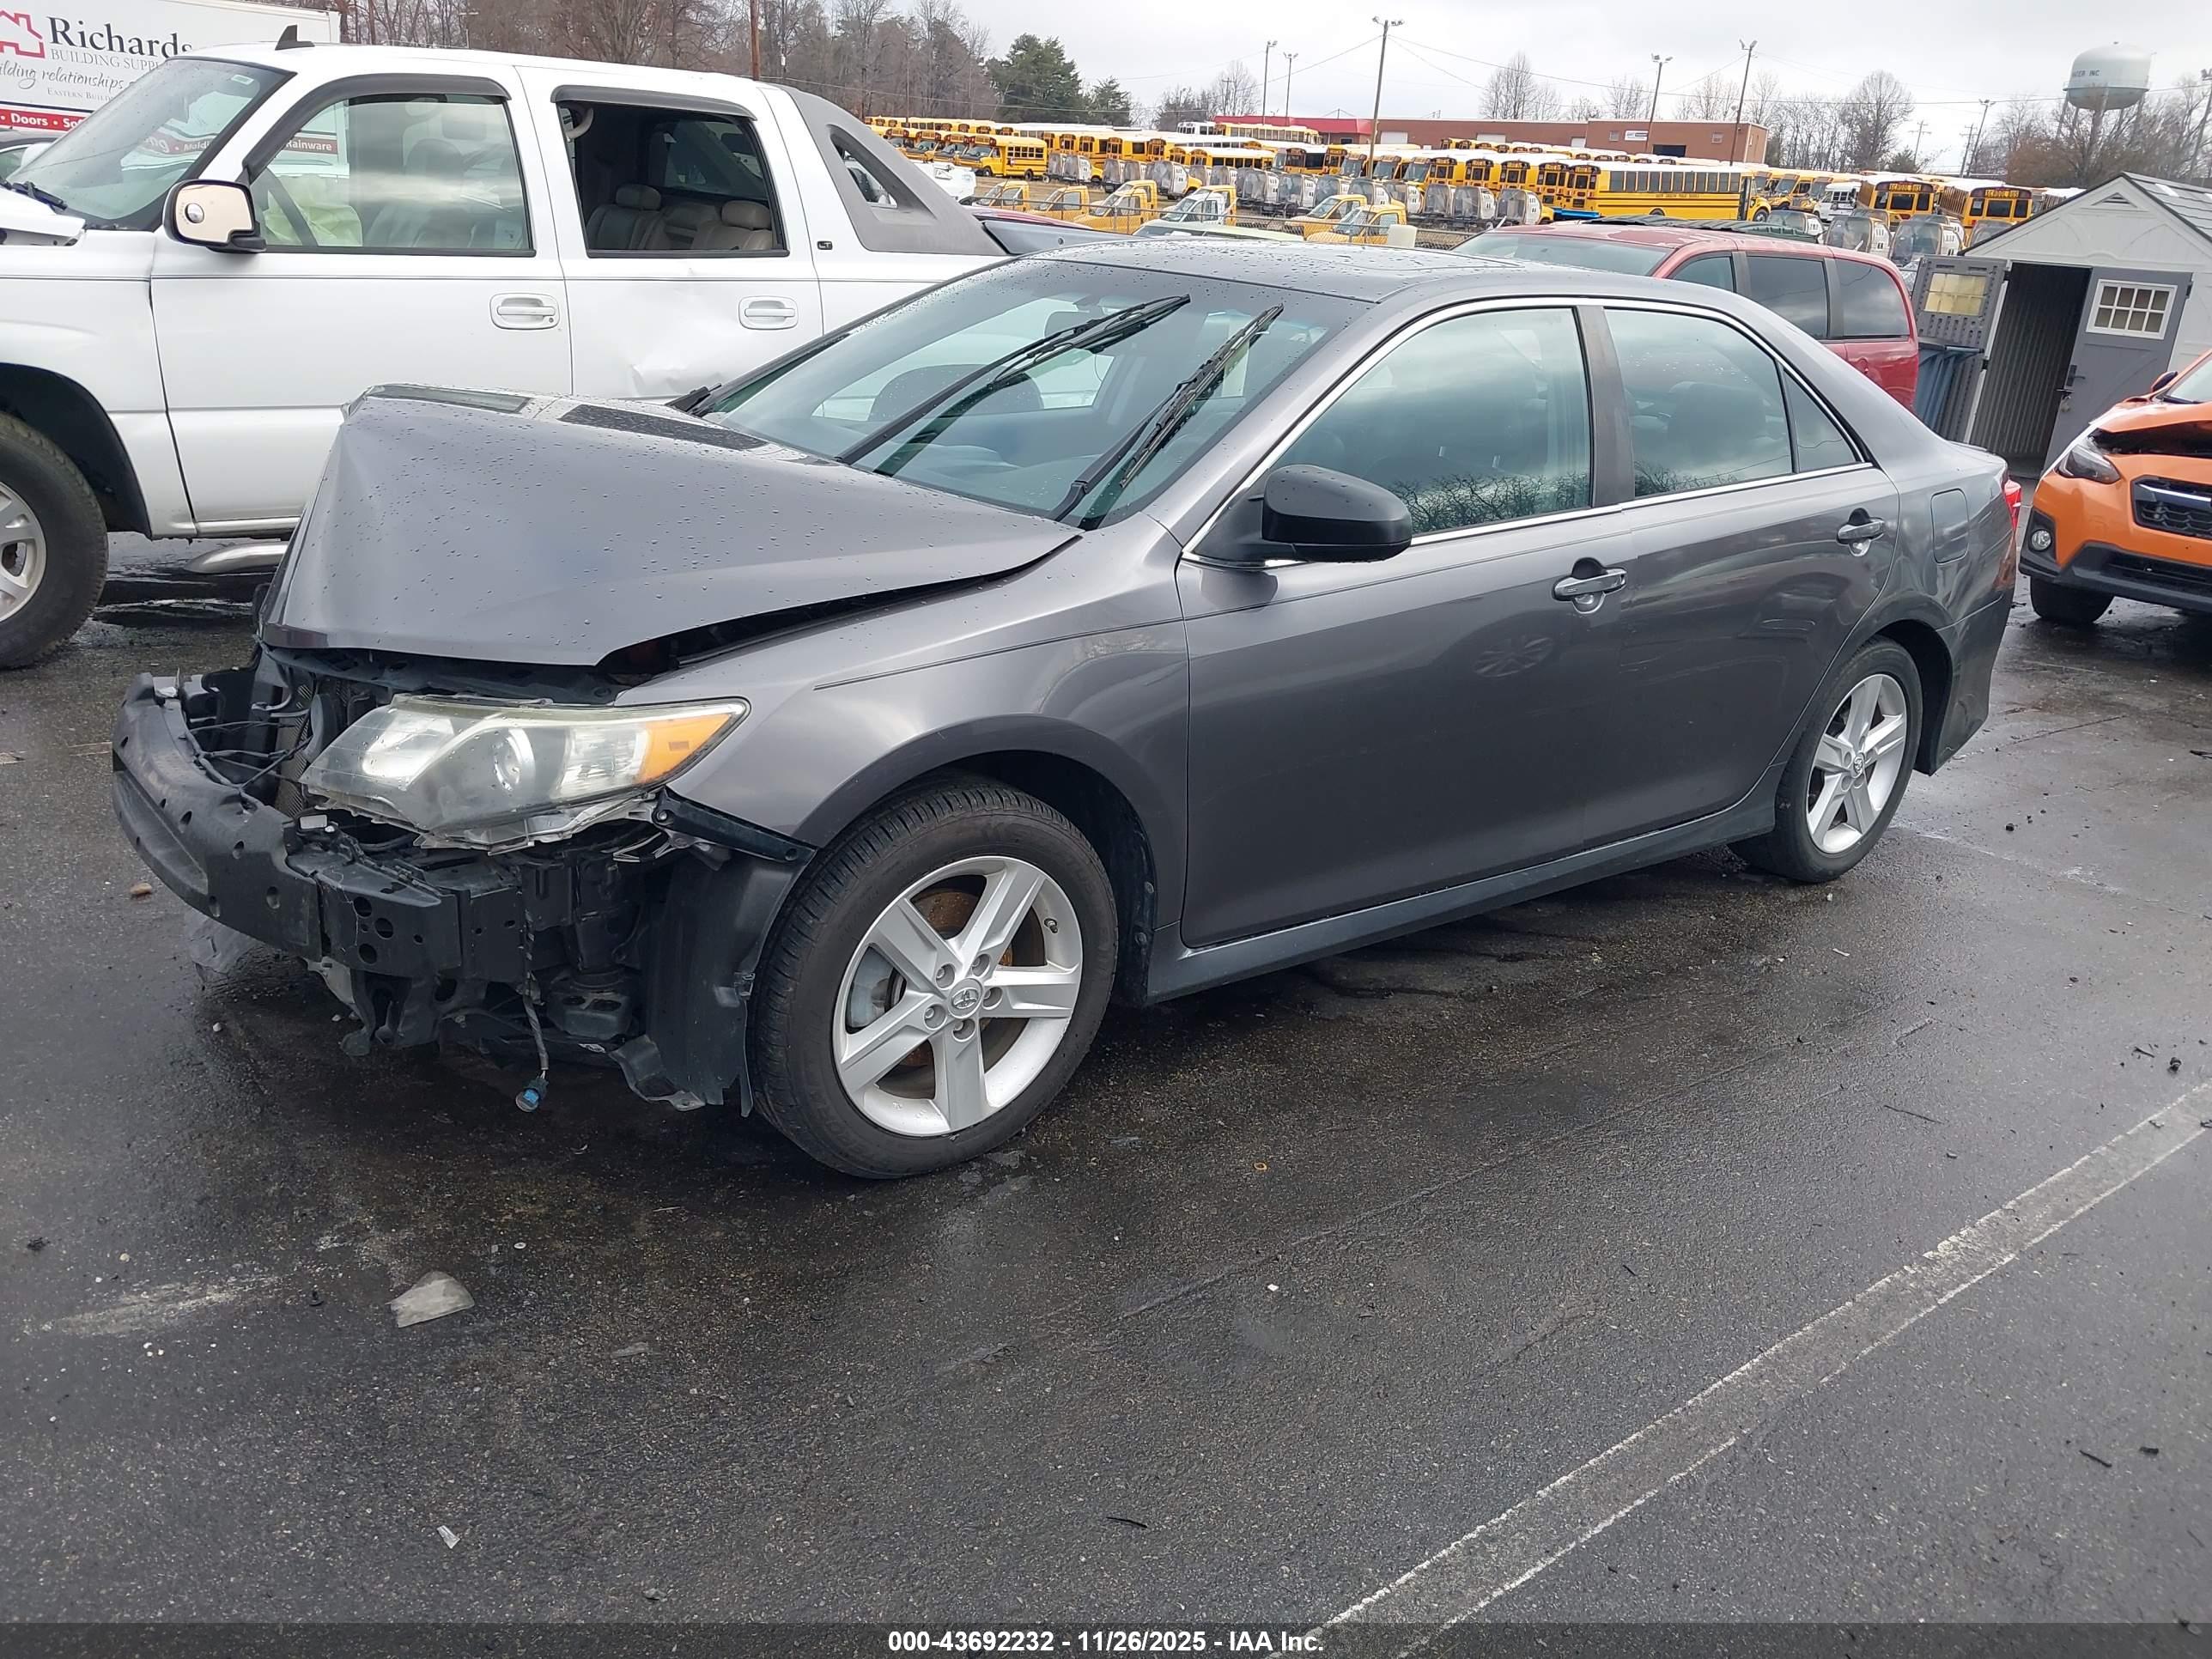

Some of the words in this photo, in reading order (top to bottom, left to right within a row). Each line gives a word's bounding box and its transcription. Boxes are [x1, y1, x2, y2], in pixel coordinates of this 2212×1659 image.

[46, 15, 192, 58] Richards
[51, 48, 120, 68] BUILDING
[42, 67, 124, 93] relationships
[47, 88, 83, 99] EASTERN
[10, 112, 49, 126] Doors
